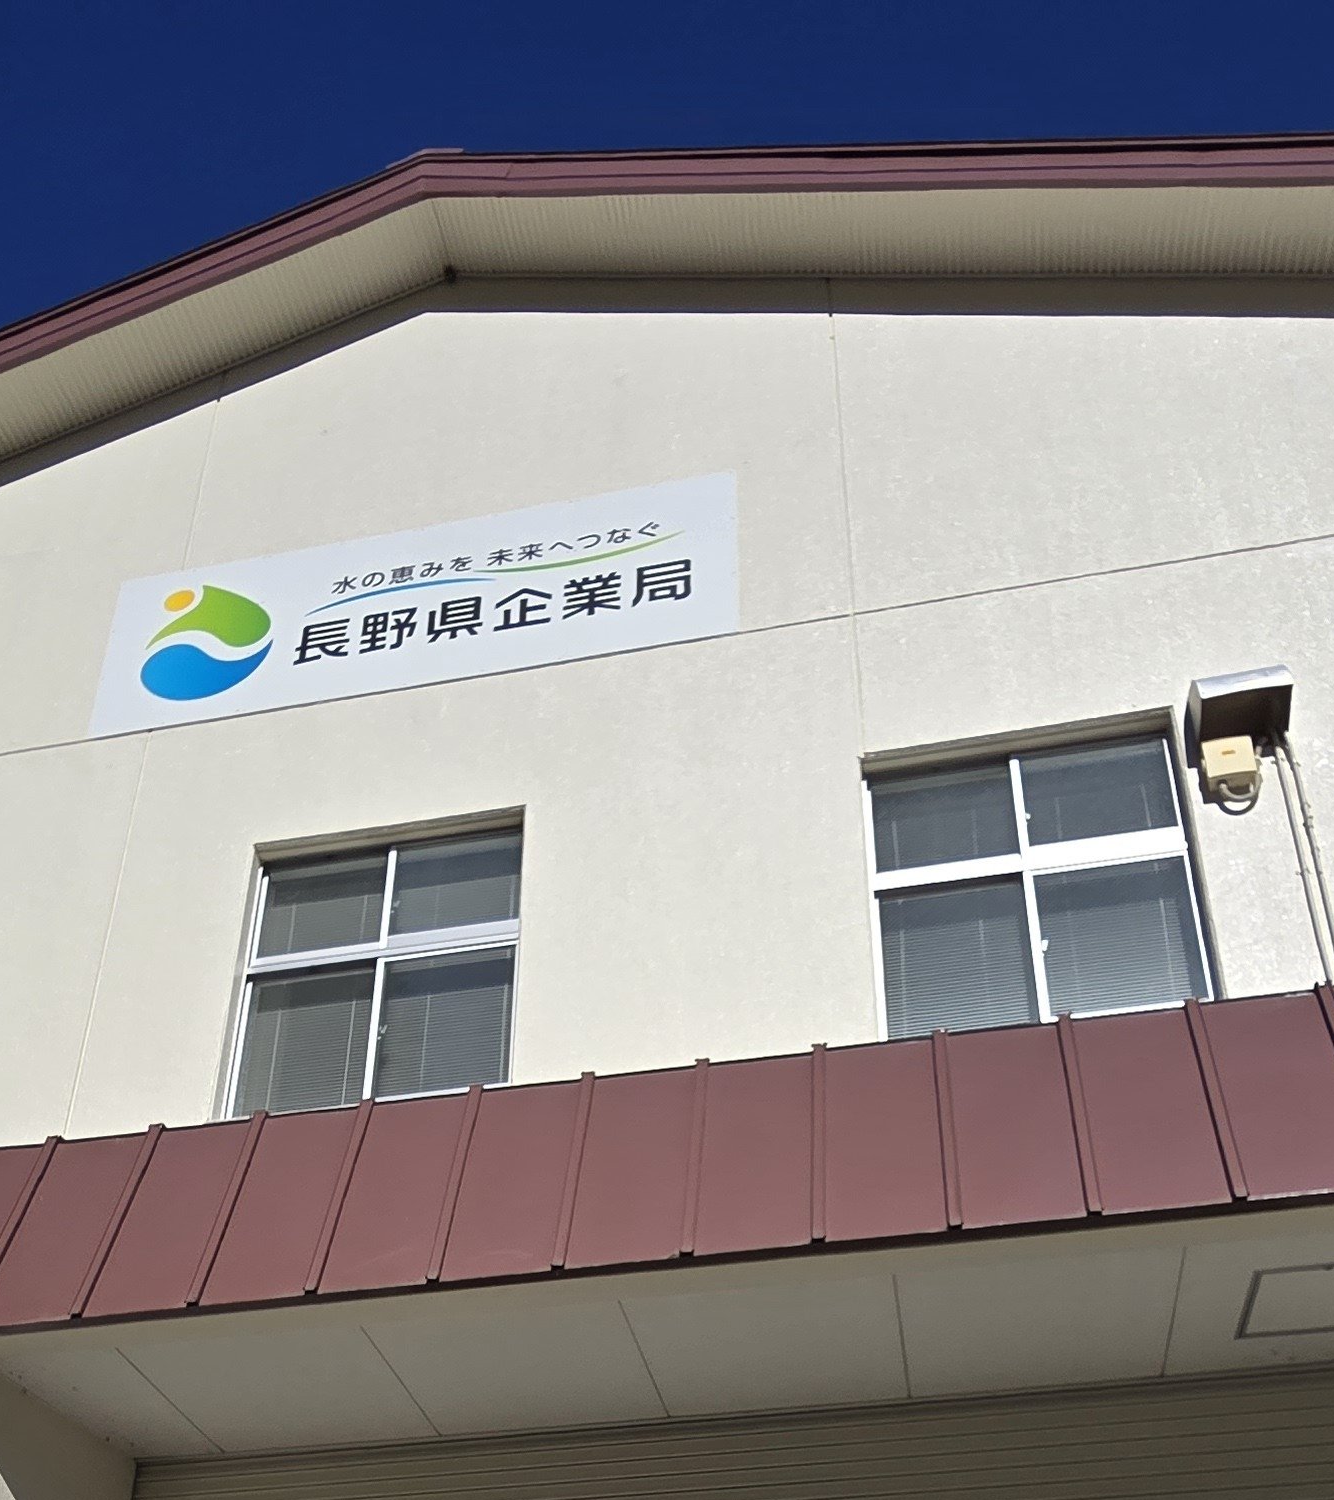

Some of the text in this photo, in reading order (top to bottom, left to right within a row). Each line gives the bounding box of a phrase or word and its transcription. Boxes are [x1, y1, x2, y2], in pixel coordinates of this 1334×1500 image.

[331, 521, 660, 594] 水の恵みを 未来へつなぐ
[292, 558, 693, 666] 長野県企業局
